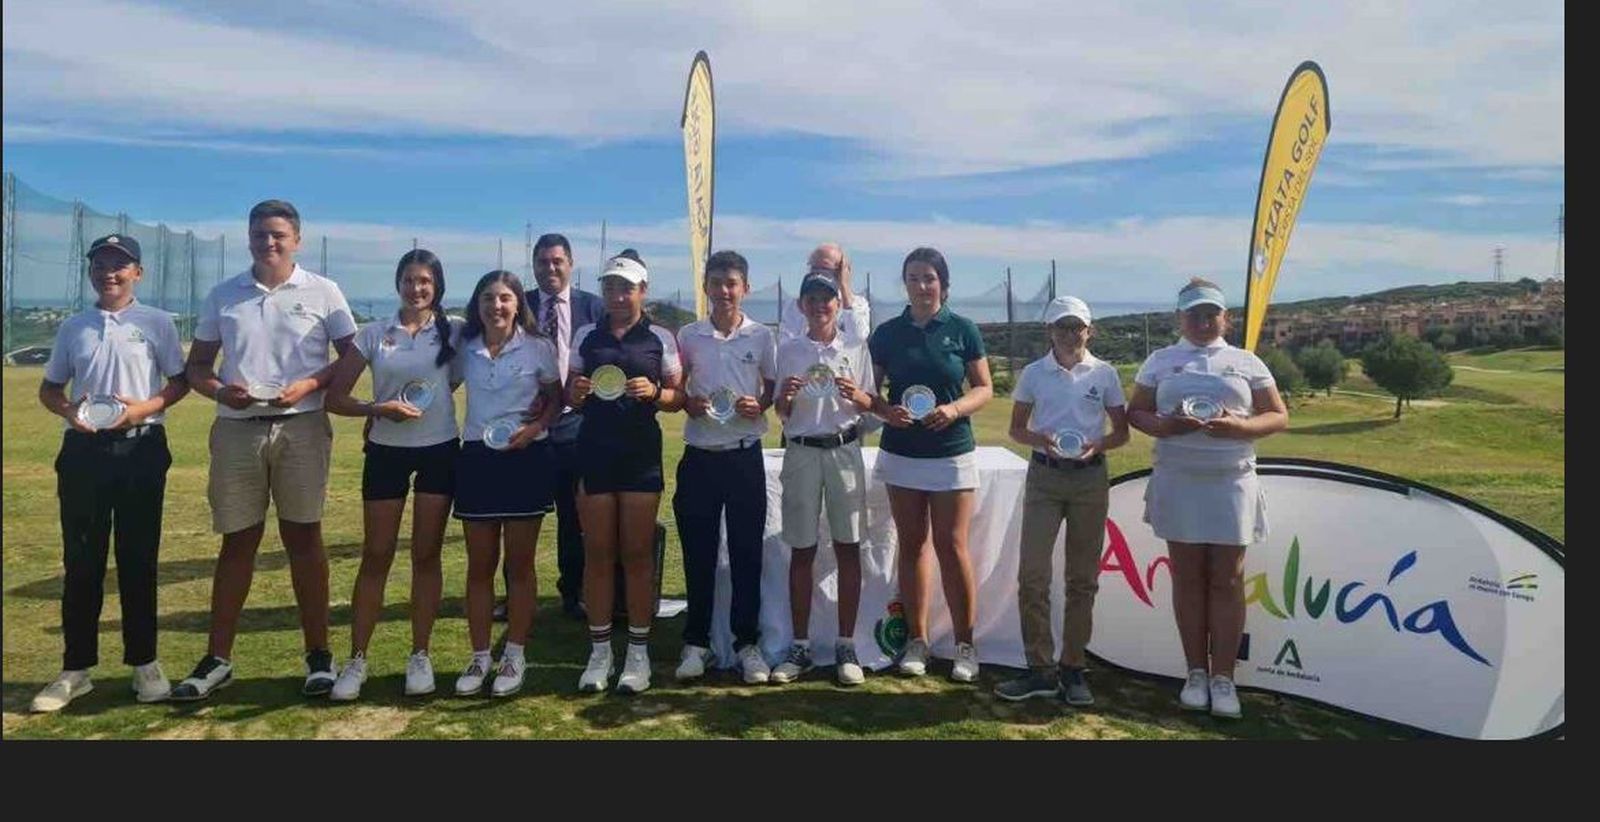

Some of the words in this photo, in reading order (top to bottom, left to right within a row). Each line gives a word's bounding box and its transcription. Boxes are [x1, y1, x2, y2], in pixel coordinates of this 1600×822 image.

[1264, 168, 1295, 249] AZATA
[1291, 93, 1319, 164] GOLF
[1097, 517, 1493, 667] Analucía
